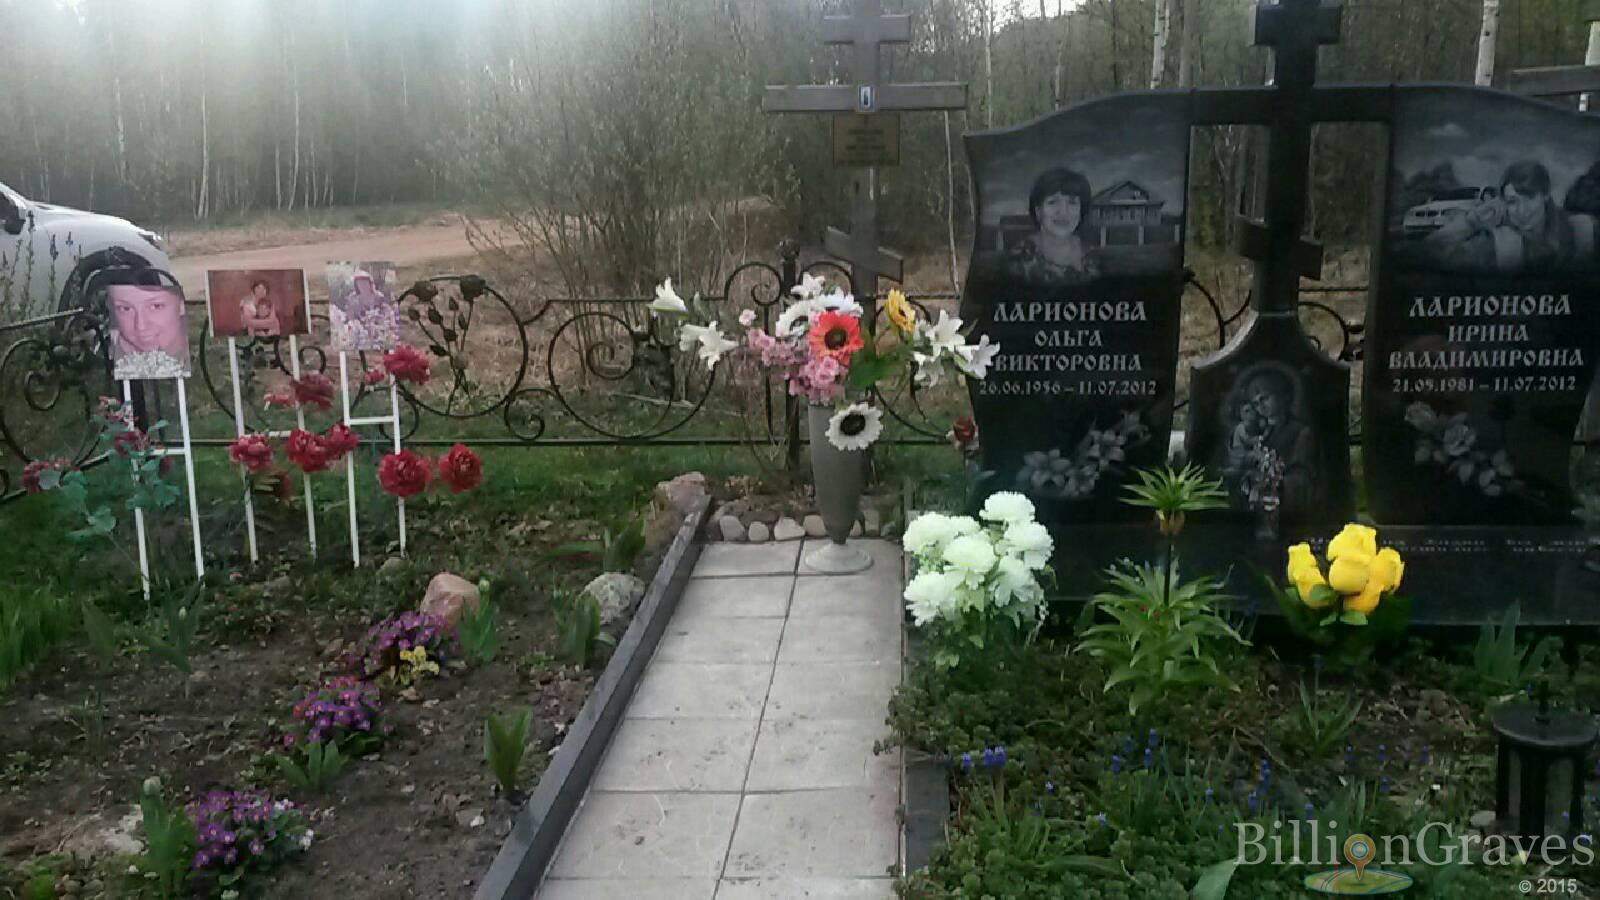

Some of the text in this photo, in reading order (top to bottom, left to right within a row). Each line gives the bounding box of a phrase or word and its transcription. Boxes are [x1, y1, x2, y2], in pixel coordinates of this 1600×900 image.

[993, 301, 1147, 322] ЛАРИОНОВА
[1409, 294, 1572, 318] ЛАРИОНОВА
[1034, 329, 1103, 347] ОЛЬГА
[1448, 324, 1529, 343] ИРИНА
[995, 354, 1142, 372] ВИКТОРОВНА
[1389, 348, 1584, 371] ВЛАДИМИРОВНА
[1079, 380, 1157, 395] 11.07.2012
[1494, 376, 1576, 392] 11.07.2012
